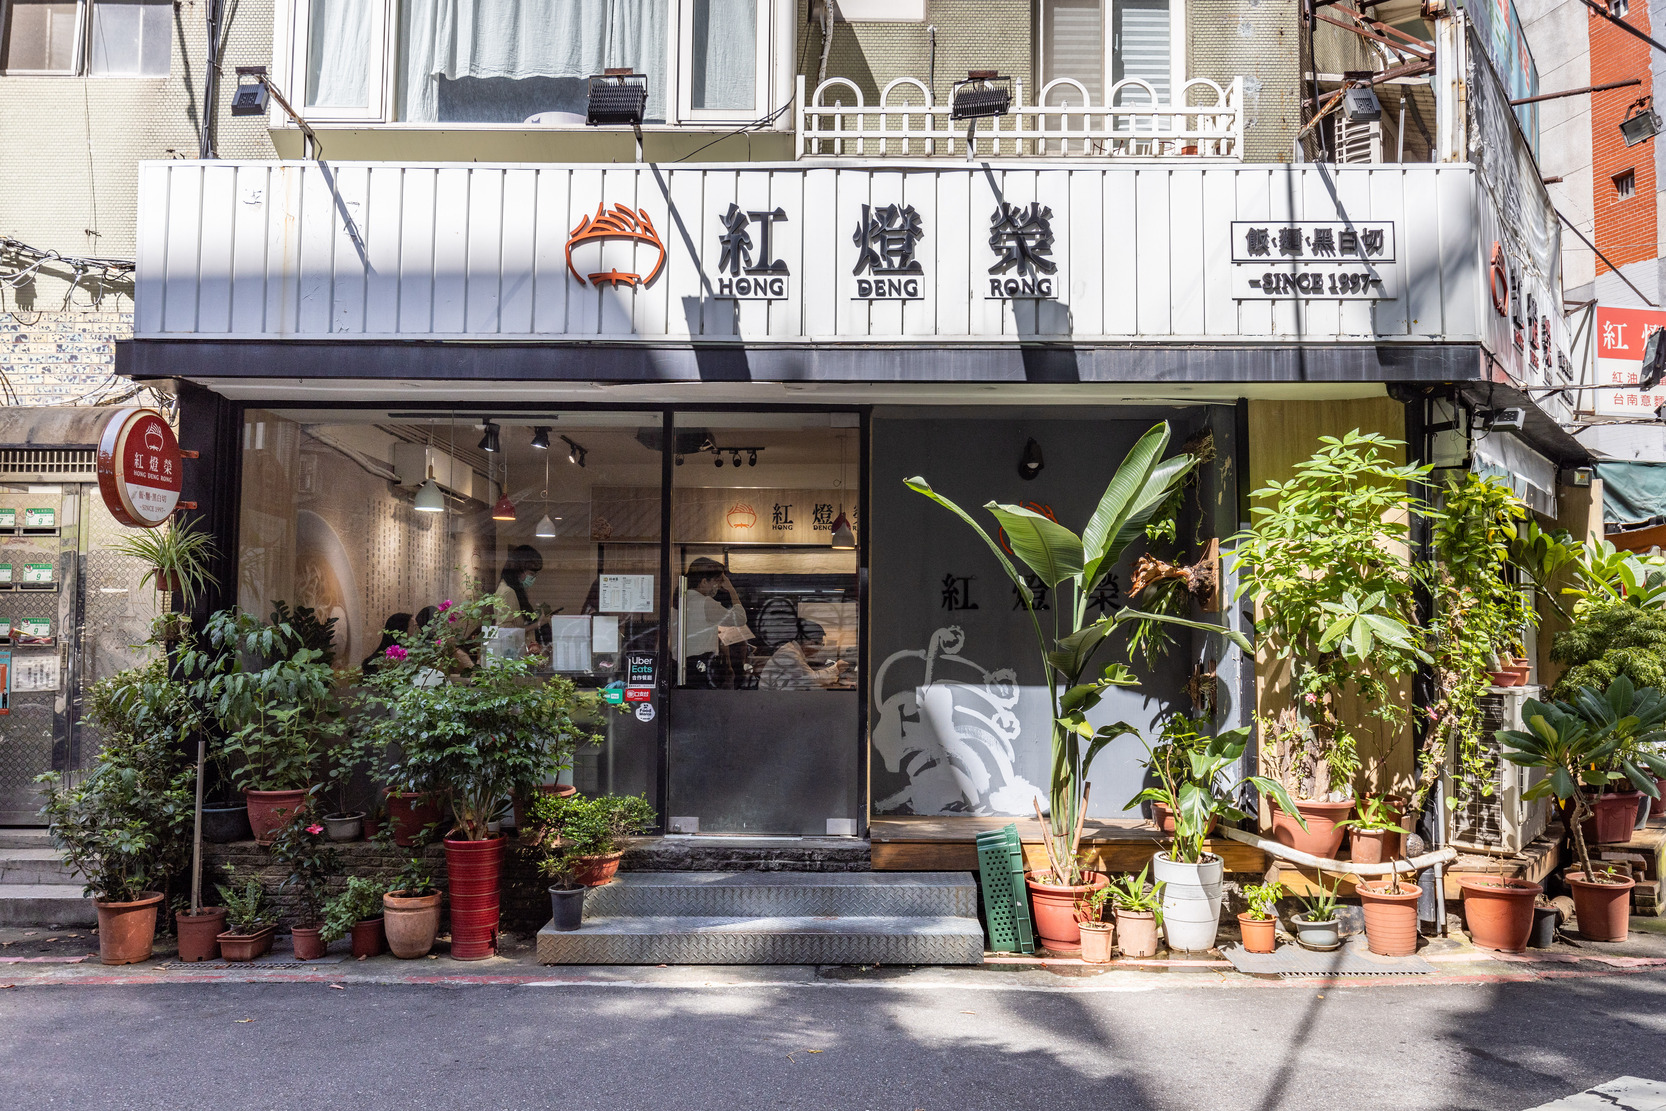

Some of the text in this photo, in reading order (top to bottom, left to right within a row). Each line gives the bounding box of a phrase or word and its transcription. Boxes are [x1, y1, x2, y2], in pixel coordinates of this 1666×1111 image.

[718, 278, 1052, 297] HONG DENG RONG
[133, 470, 173, 483] HONG DENG RONG
[632, 656, 653, 665] Uber
[632, 665, 653, 673] Eats
